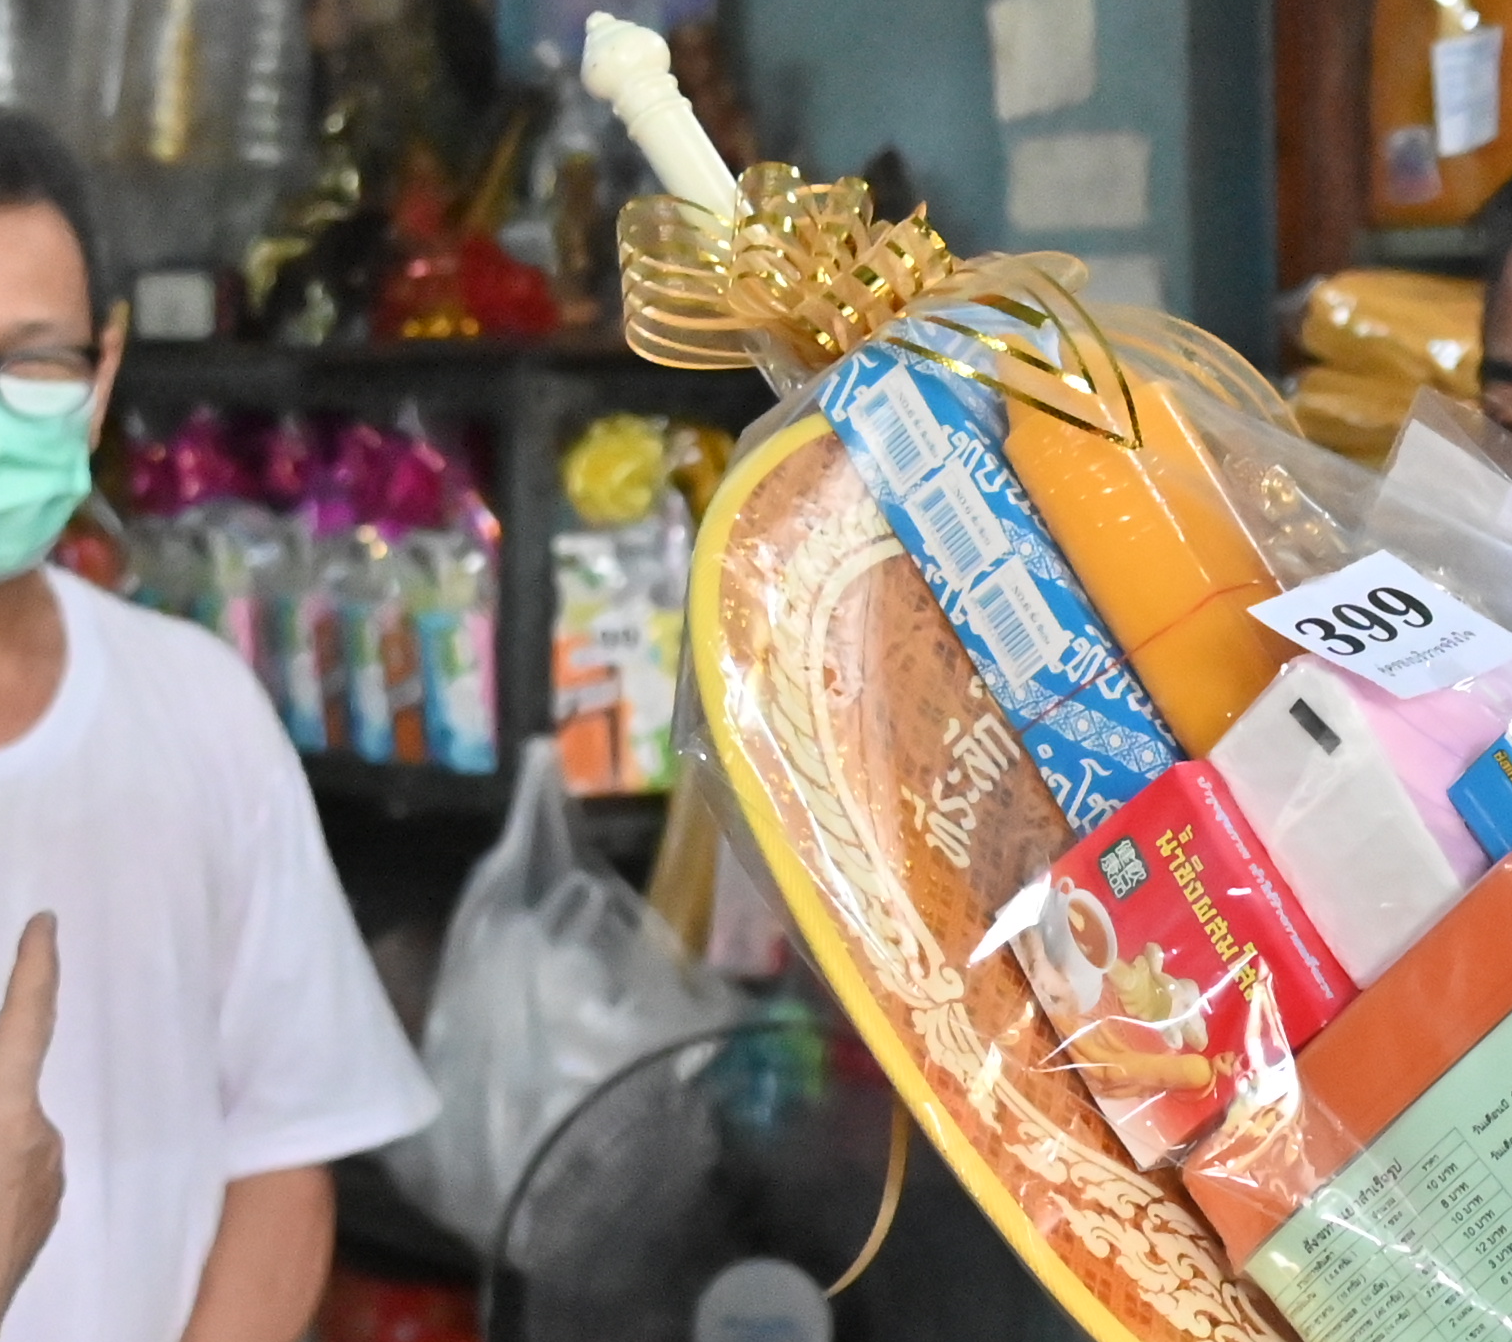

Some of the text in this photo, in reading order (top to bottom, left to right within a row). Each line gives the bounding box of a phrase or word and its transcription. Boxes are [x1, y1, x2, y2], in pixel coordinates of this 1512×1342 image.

[1294, 587, 1434, 656] 399
[1156, 824, 1258, 1002] น้ำขิงผสมโส
[1426, 1162, 1458, 1190] 10 บาท
[1448, 1181, 1470, 1202] บาท
[1450, 1194, 1484, 1225] 10 บาท
[1462, 1209, 1496, 1240] 10 บาท
[1475, 1224, 1508, 1255] 12 บาท
[1488, 1259, 1497, 1270] 3
[1500, 1275, 1509, 1285] 6
